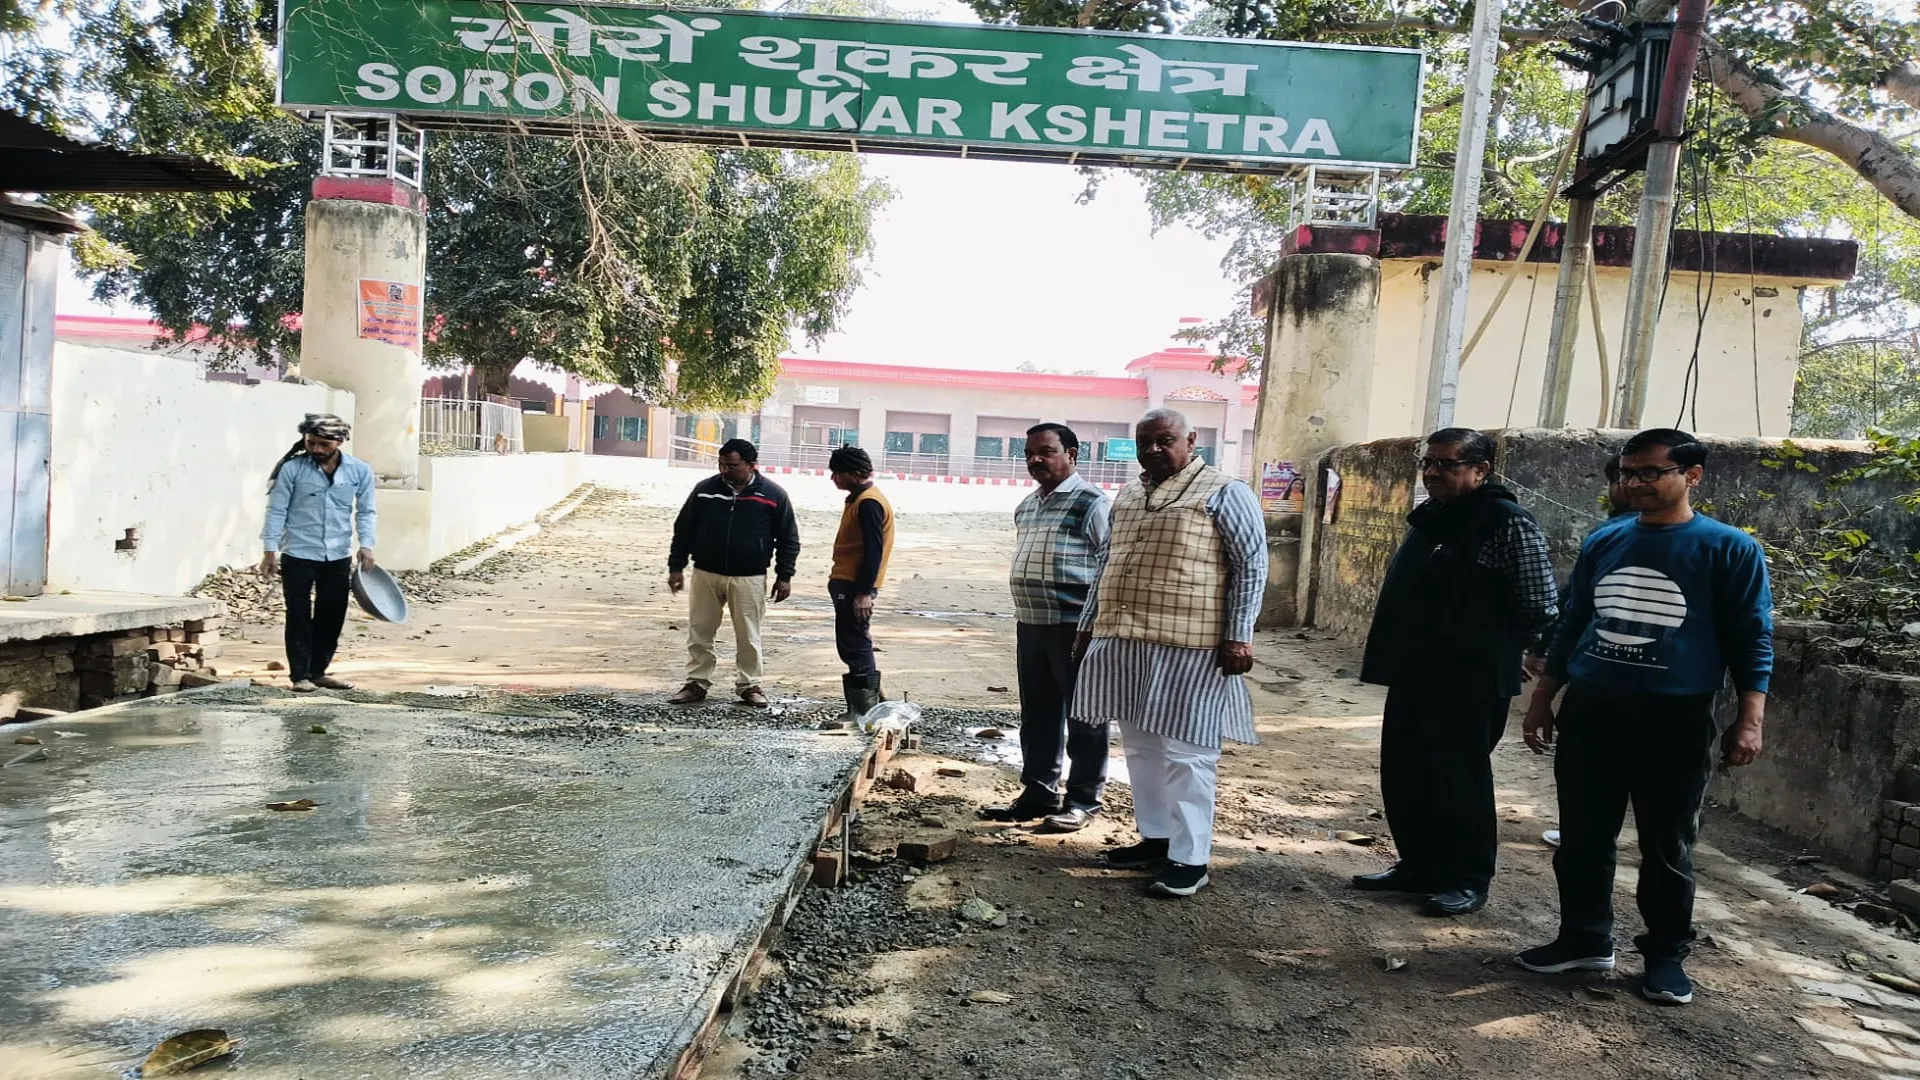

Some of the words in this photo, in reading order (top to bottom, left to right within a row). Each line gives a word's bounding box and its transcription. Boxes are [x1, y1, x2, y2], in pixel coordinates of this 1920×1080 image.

[450, 8, 722, 63] सोरों
[738, 35, 1043, 90] शूकर
[1066, 44, 1259, 97] क्षेत्र
[355, 62, 620, 115] SORON
[647, 79, 963, 136] SHUKAR
[991, 101, 1340, 156] KSHETRA
